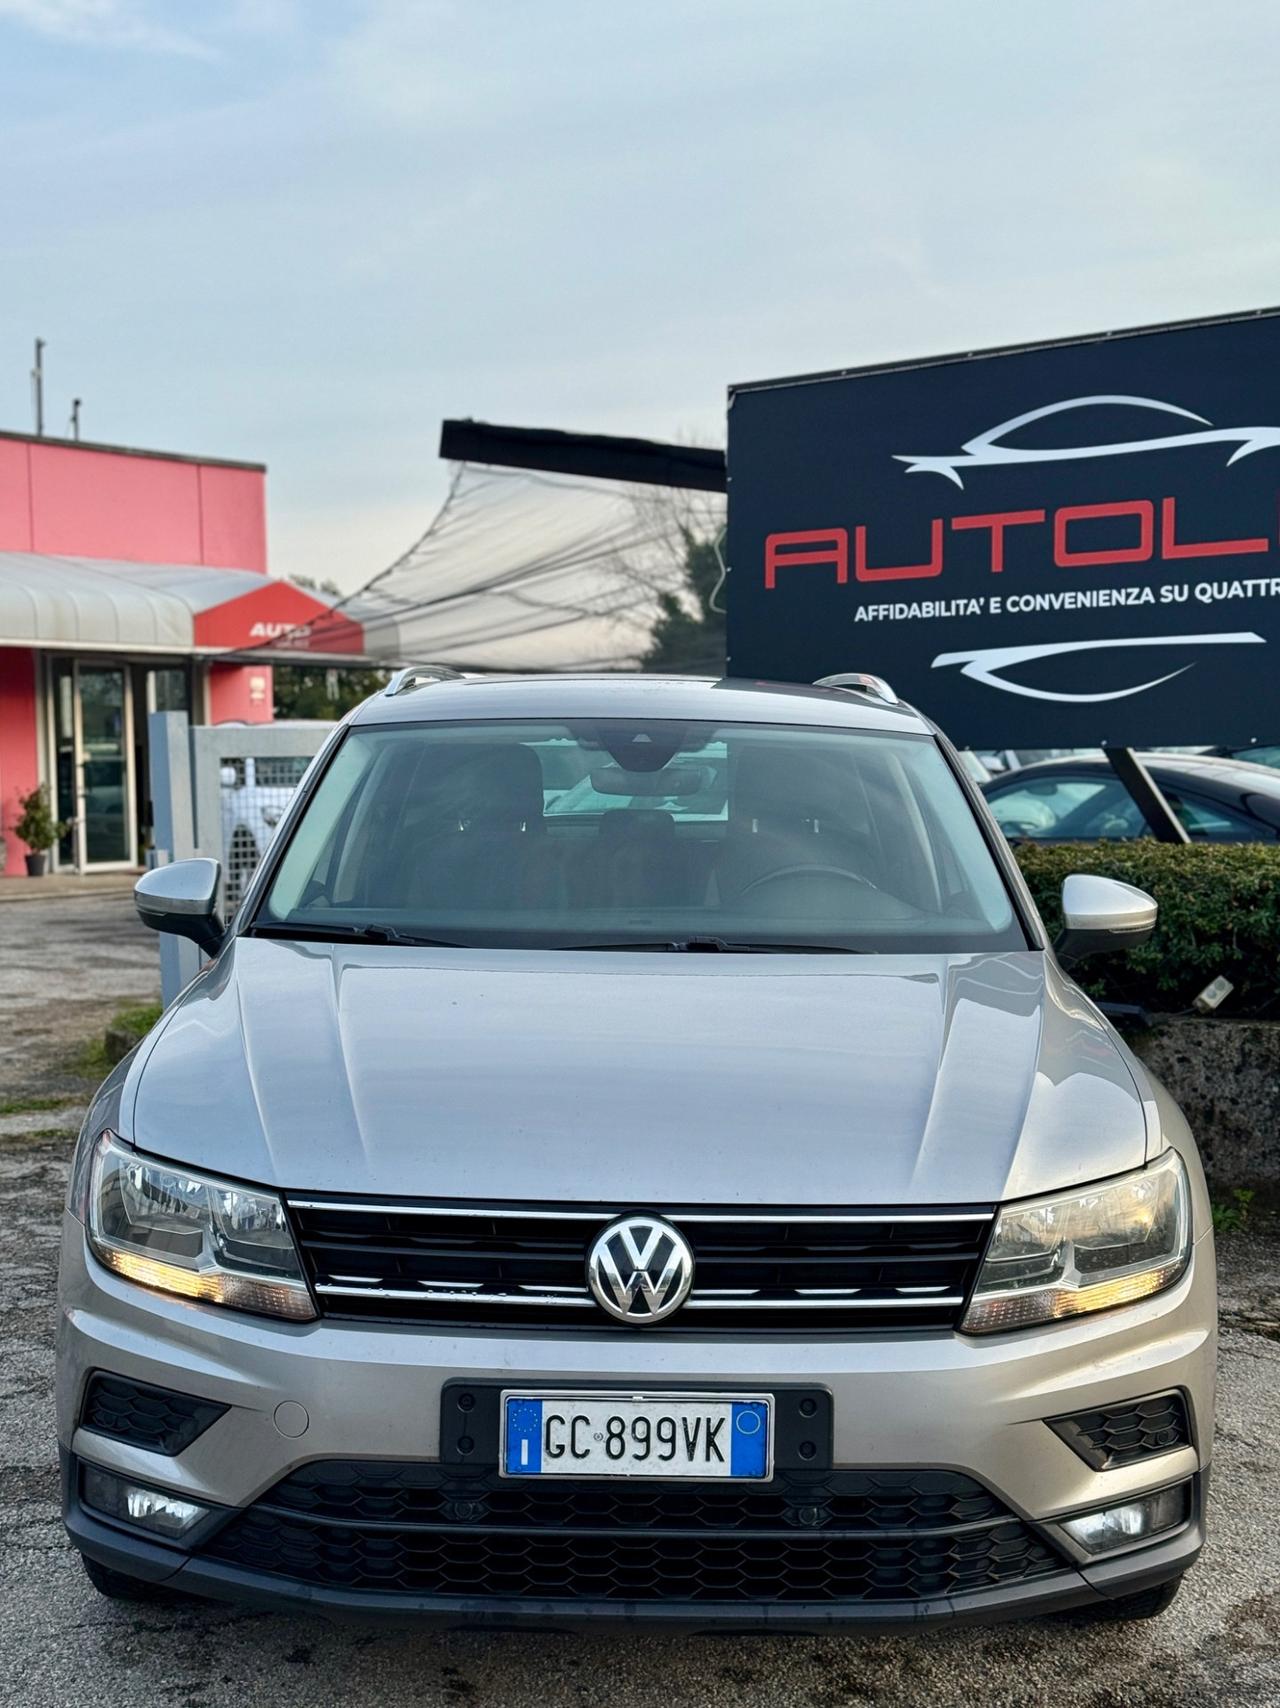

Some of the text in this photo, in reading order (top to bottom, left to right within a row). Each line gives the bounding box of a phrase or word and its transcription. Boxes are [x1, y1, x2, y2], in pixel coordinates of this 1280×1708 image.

[764, 489, 1280, 589] AUTOL
[854, 597, 985, 622] AFFIDABILITA'
[990, 596, 1002, 614] E
[1005, 586, 1156, 613] CONVENIENZA
[1159, 583, 1189, 604] SU
[593, 1219, 689, 1320] VW
